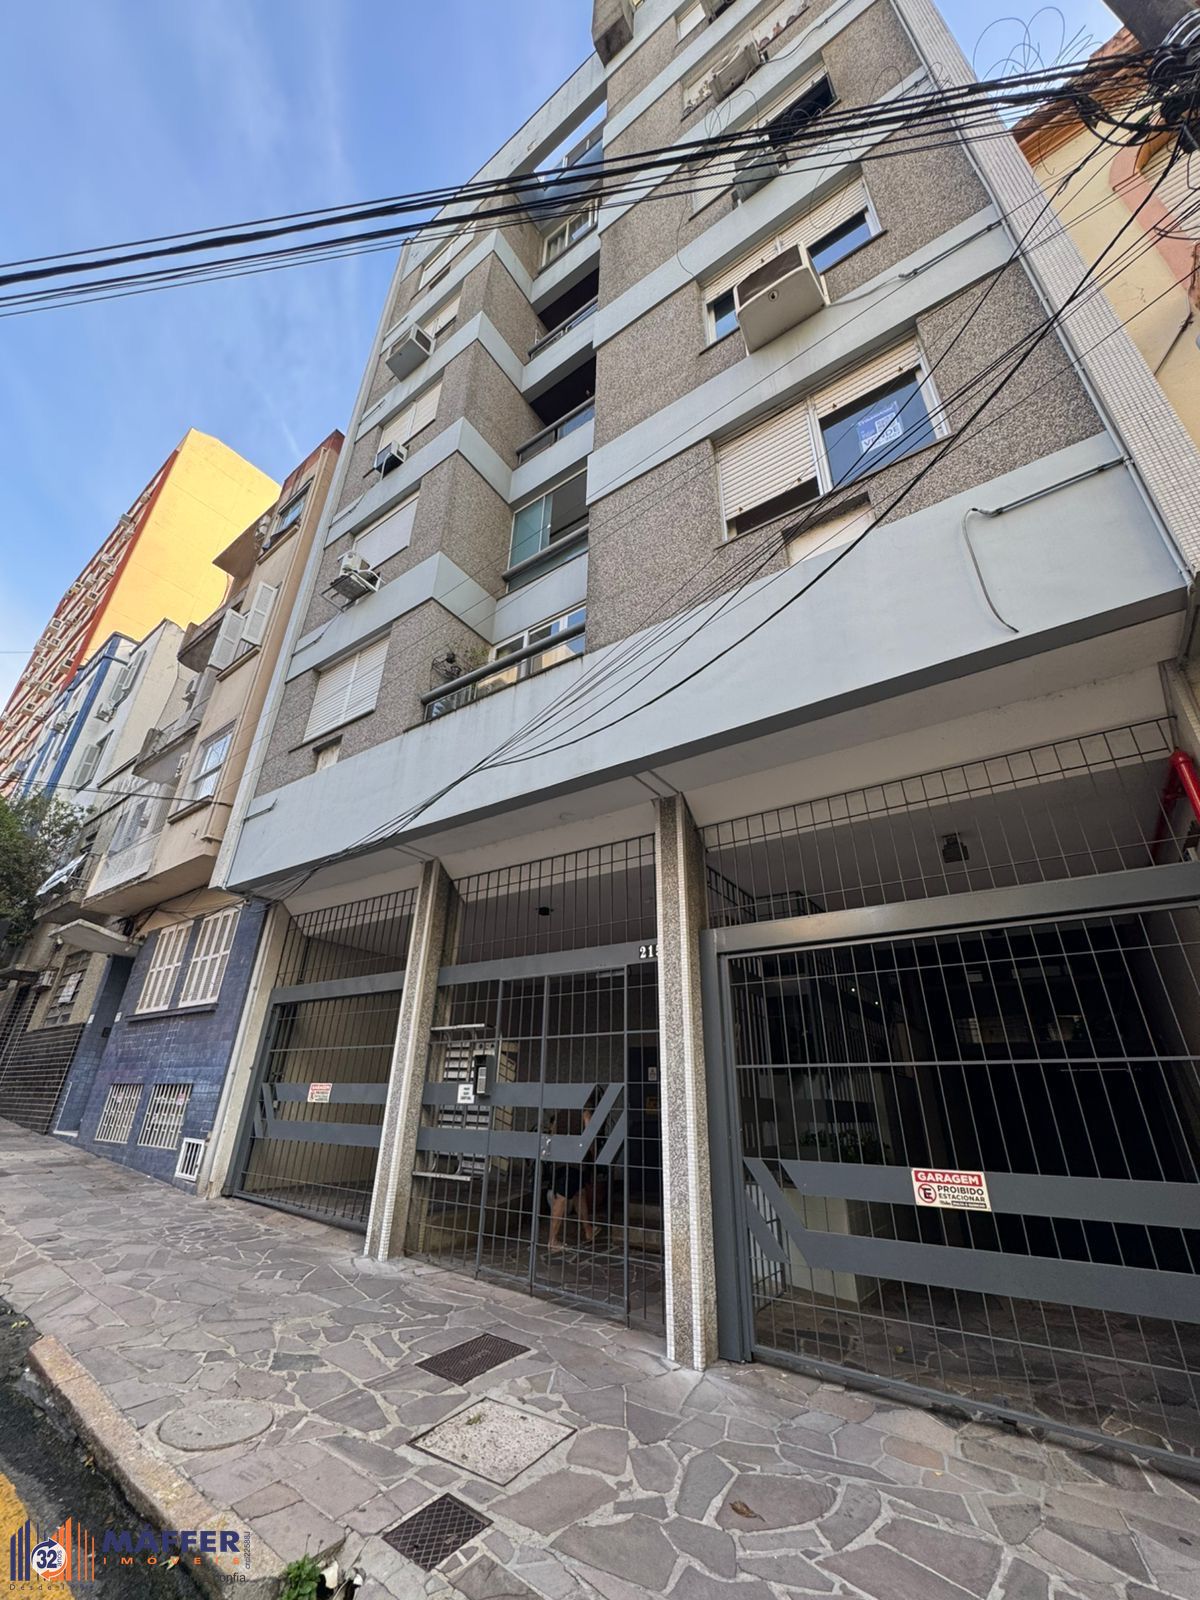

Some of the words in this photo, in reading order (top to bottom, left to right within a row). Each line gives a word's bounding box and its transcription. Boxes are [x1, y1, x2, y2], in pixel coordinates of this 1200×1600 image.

[863, 426, 898, 446] VDE
[917, 1172, 979, 1185] GARAGEM
[937, 1185, 984, 1196] PROIBIDO
[938, 1193, 986, 1202] ESTACIONAR
